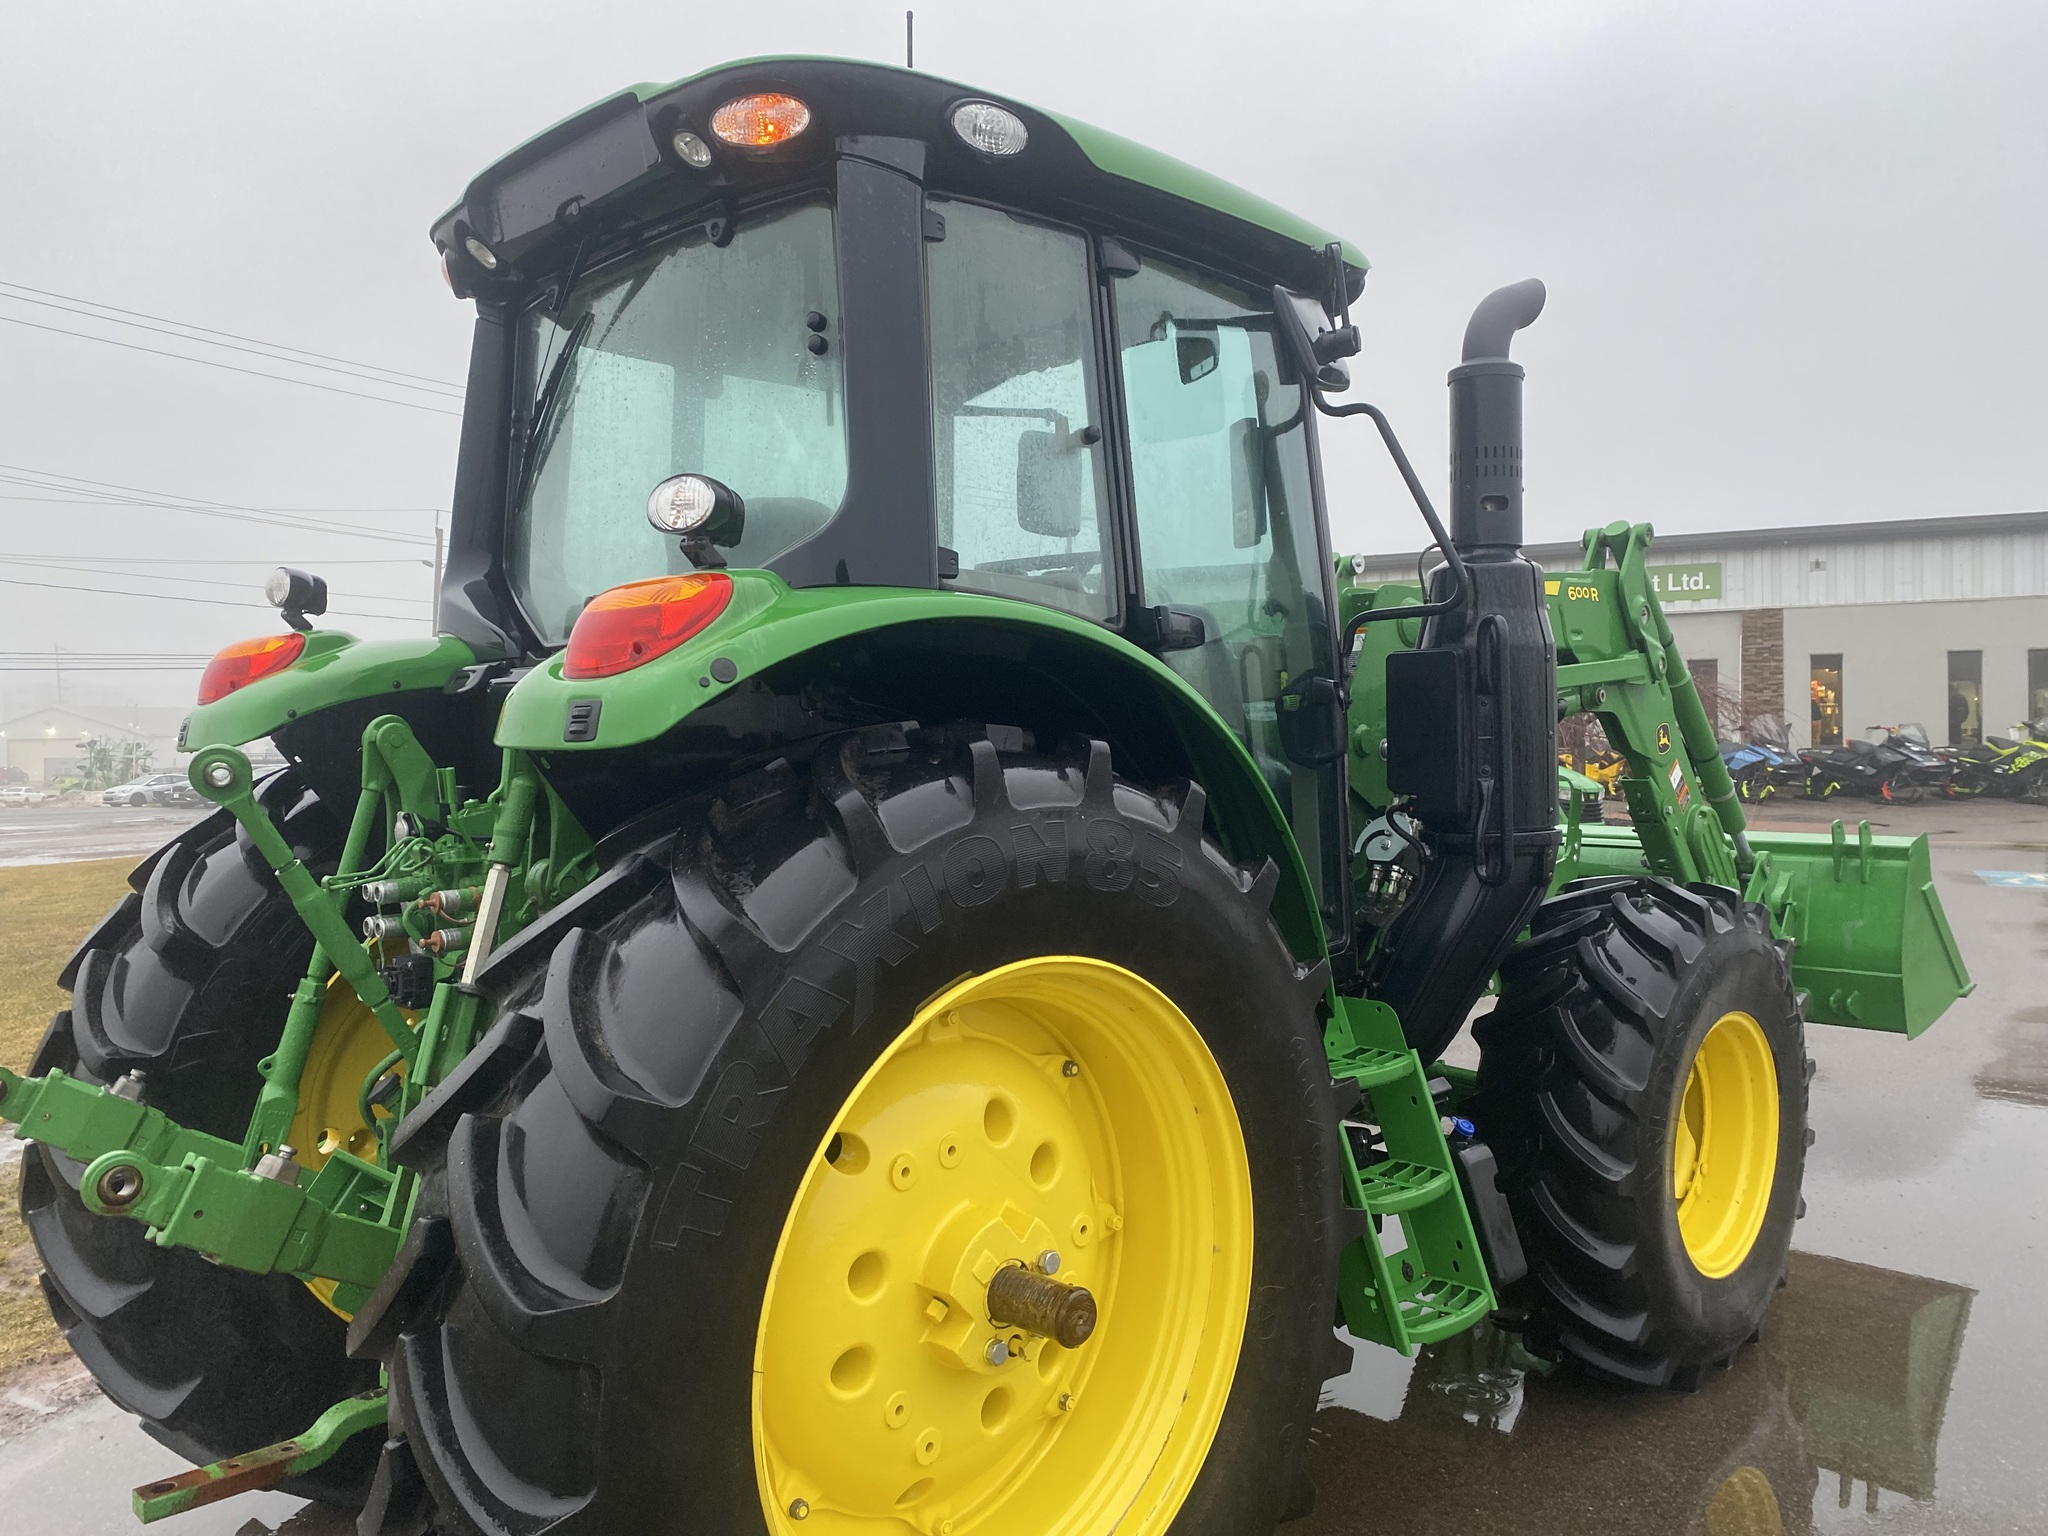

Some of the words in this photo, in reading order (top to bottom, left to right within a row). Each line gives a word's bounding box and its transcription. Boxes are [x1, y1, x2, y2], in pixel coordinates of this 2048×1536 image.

[1668, 571, 1711, 591] Ltd.
[650, 818, 1070, 1252] TRAXION
[1085, 817, 1184, 908] 85
